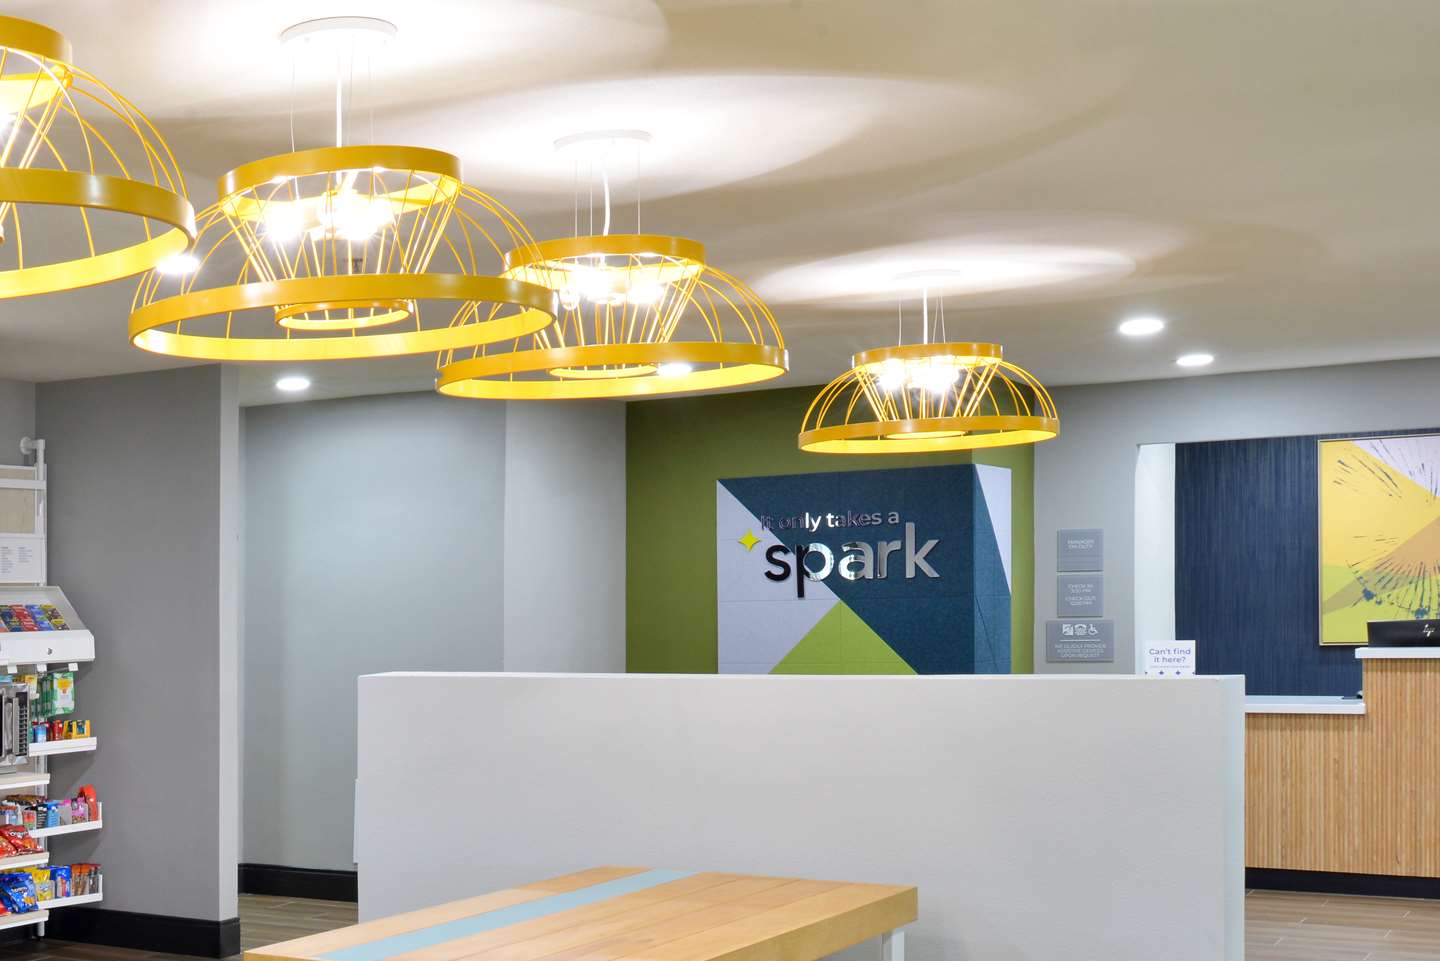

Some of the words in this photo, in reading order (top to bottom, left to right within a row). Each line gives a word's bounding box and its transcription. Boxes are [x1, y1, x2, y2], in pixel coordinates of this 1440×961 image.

[778, 512, 822, 533] only
[825, 510, 882, 528] takes
[887, 511, 900, 525] a
[764, 522, 940, 598] spark
